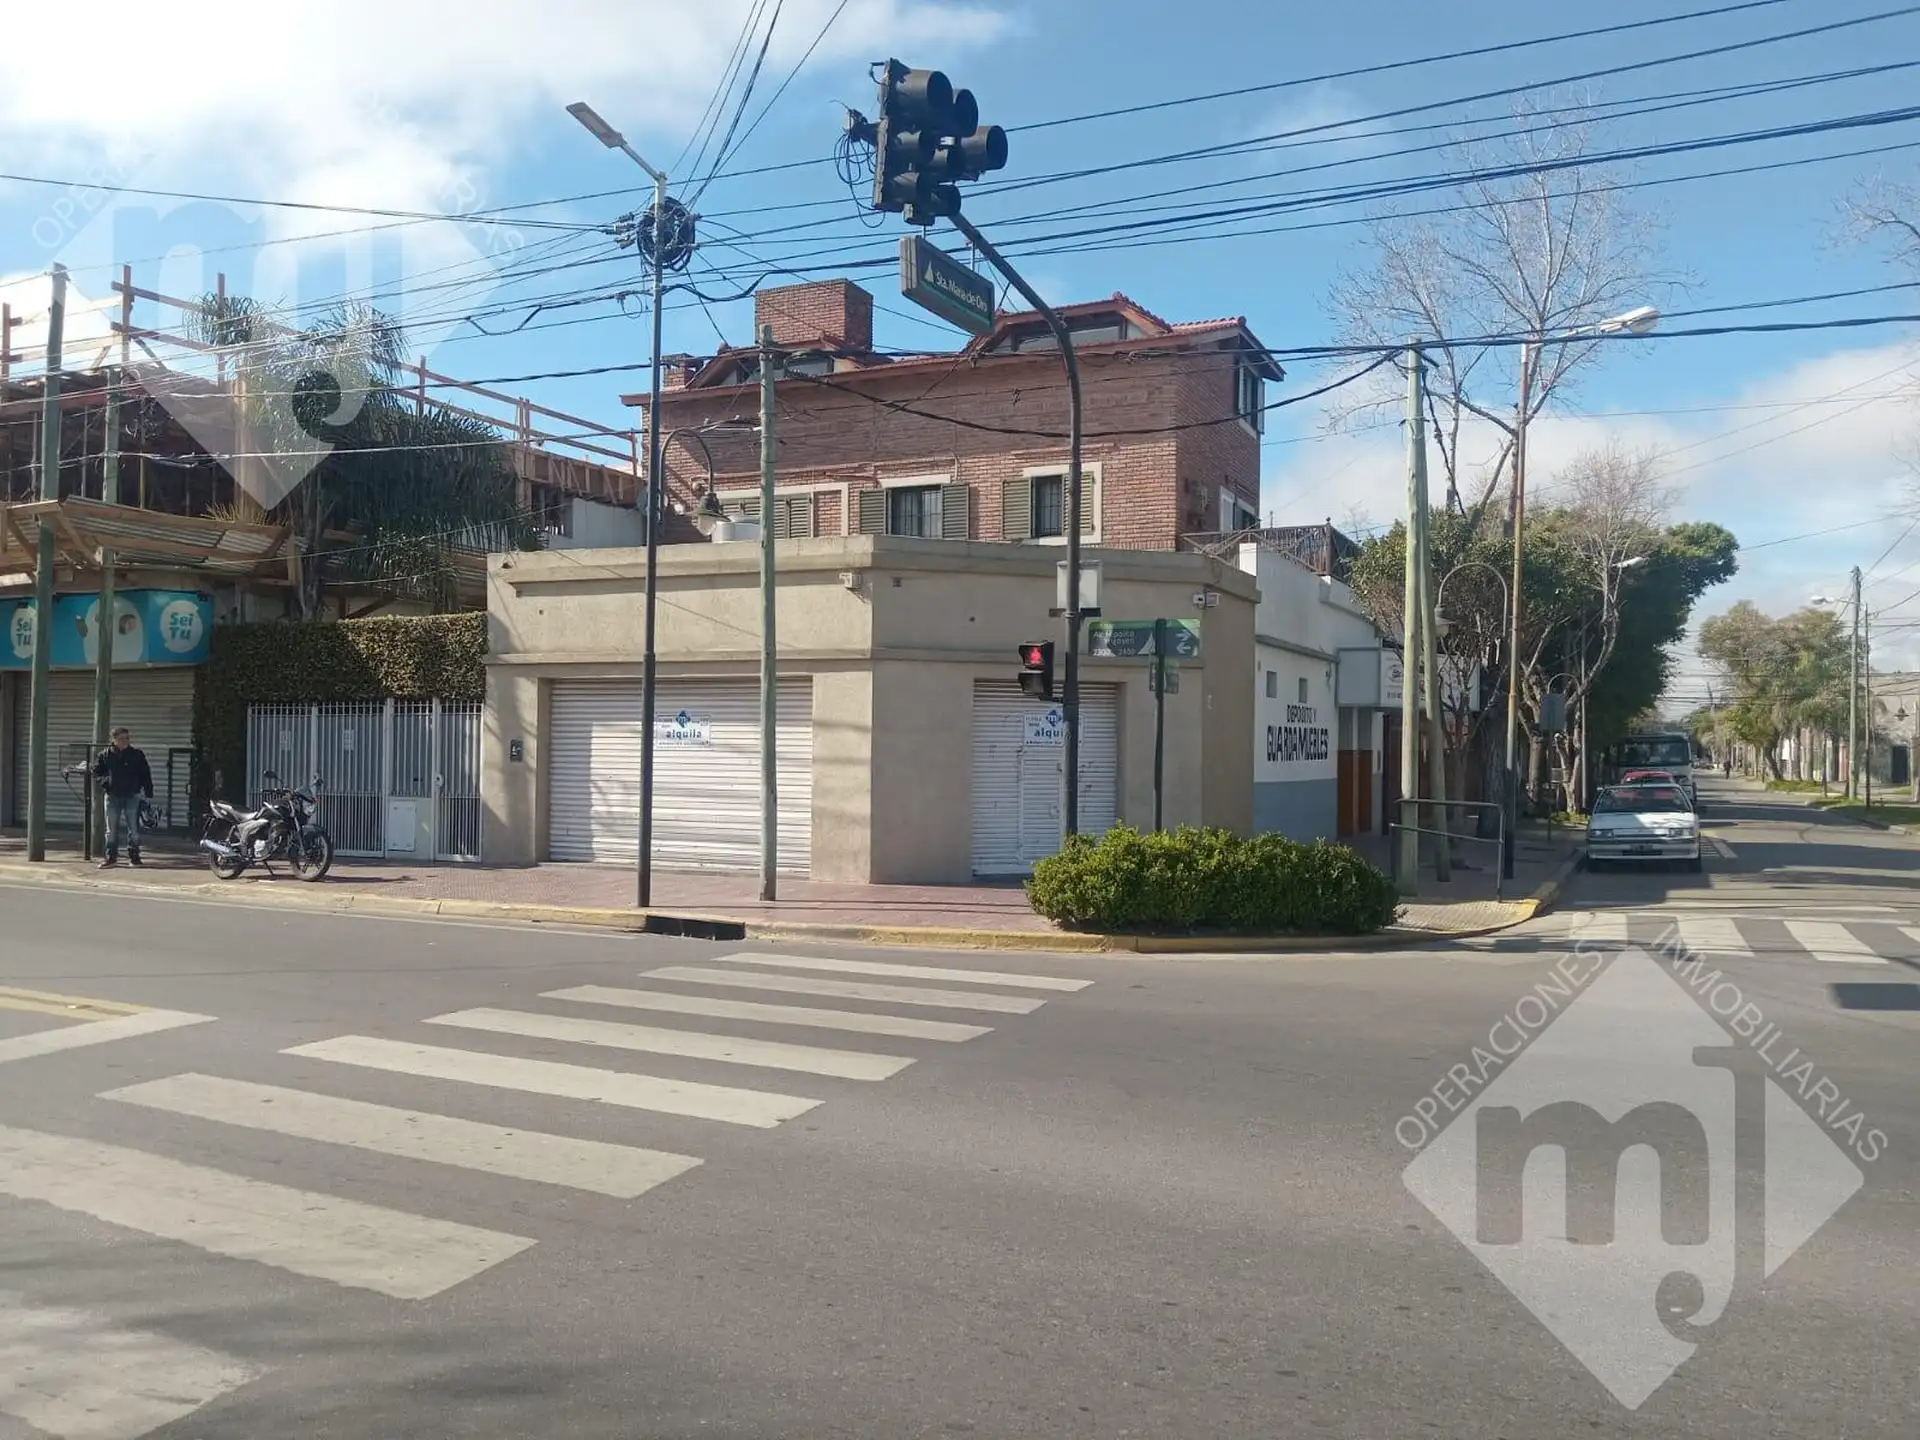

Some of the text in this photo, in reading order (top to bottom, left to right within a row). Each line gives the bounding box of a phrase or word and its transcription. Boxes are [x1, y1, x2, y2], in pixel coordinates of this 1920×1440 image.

[16, 617, 33, 631] Sei
[169, 612, 194, 626] Sei
[665, 729, 702, 740] alquila
[1034, 727, 1064, 740] alqui
